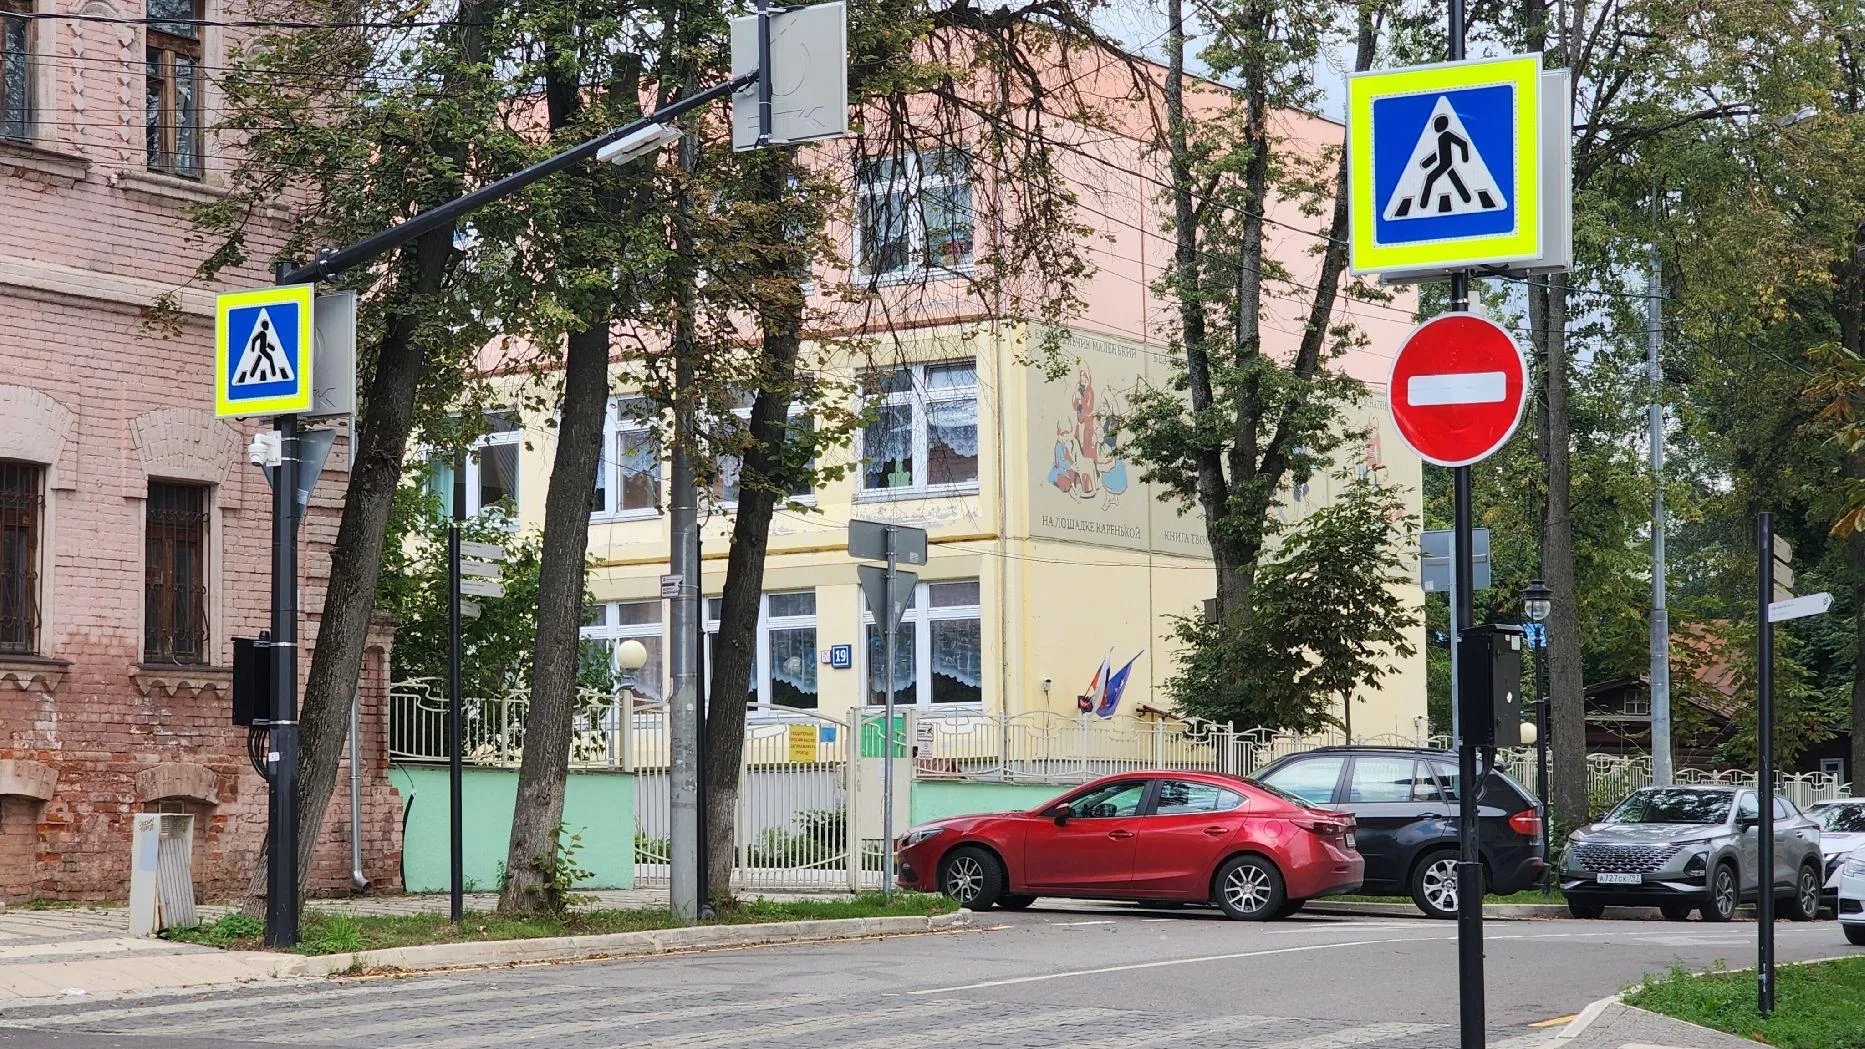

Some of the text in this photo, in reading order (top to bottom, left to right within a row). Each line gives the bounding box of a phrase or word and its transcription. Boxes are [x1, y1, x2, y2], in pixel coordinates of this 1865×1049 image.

[1042, 515, 1141, 540] НА ЛОШАДКЕ КАРЕНЬКОЙ
[1164, 530, 1190, 544] КНИГА
[835, 649, 846, 662] 19
